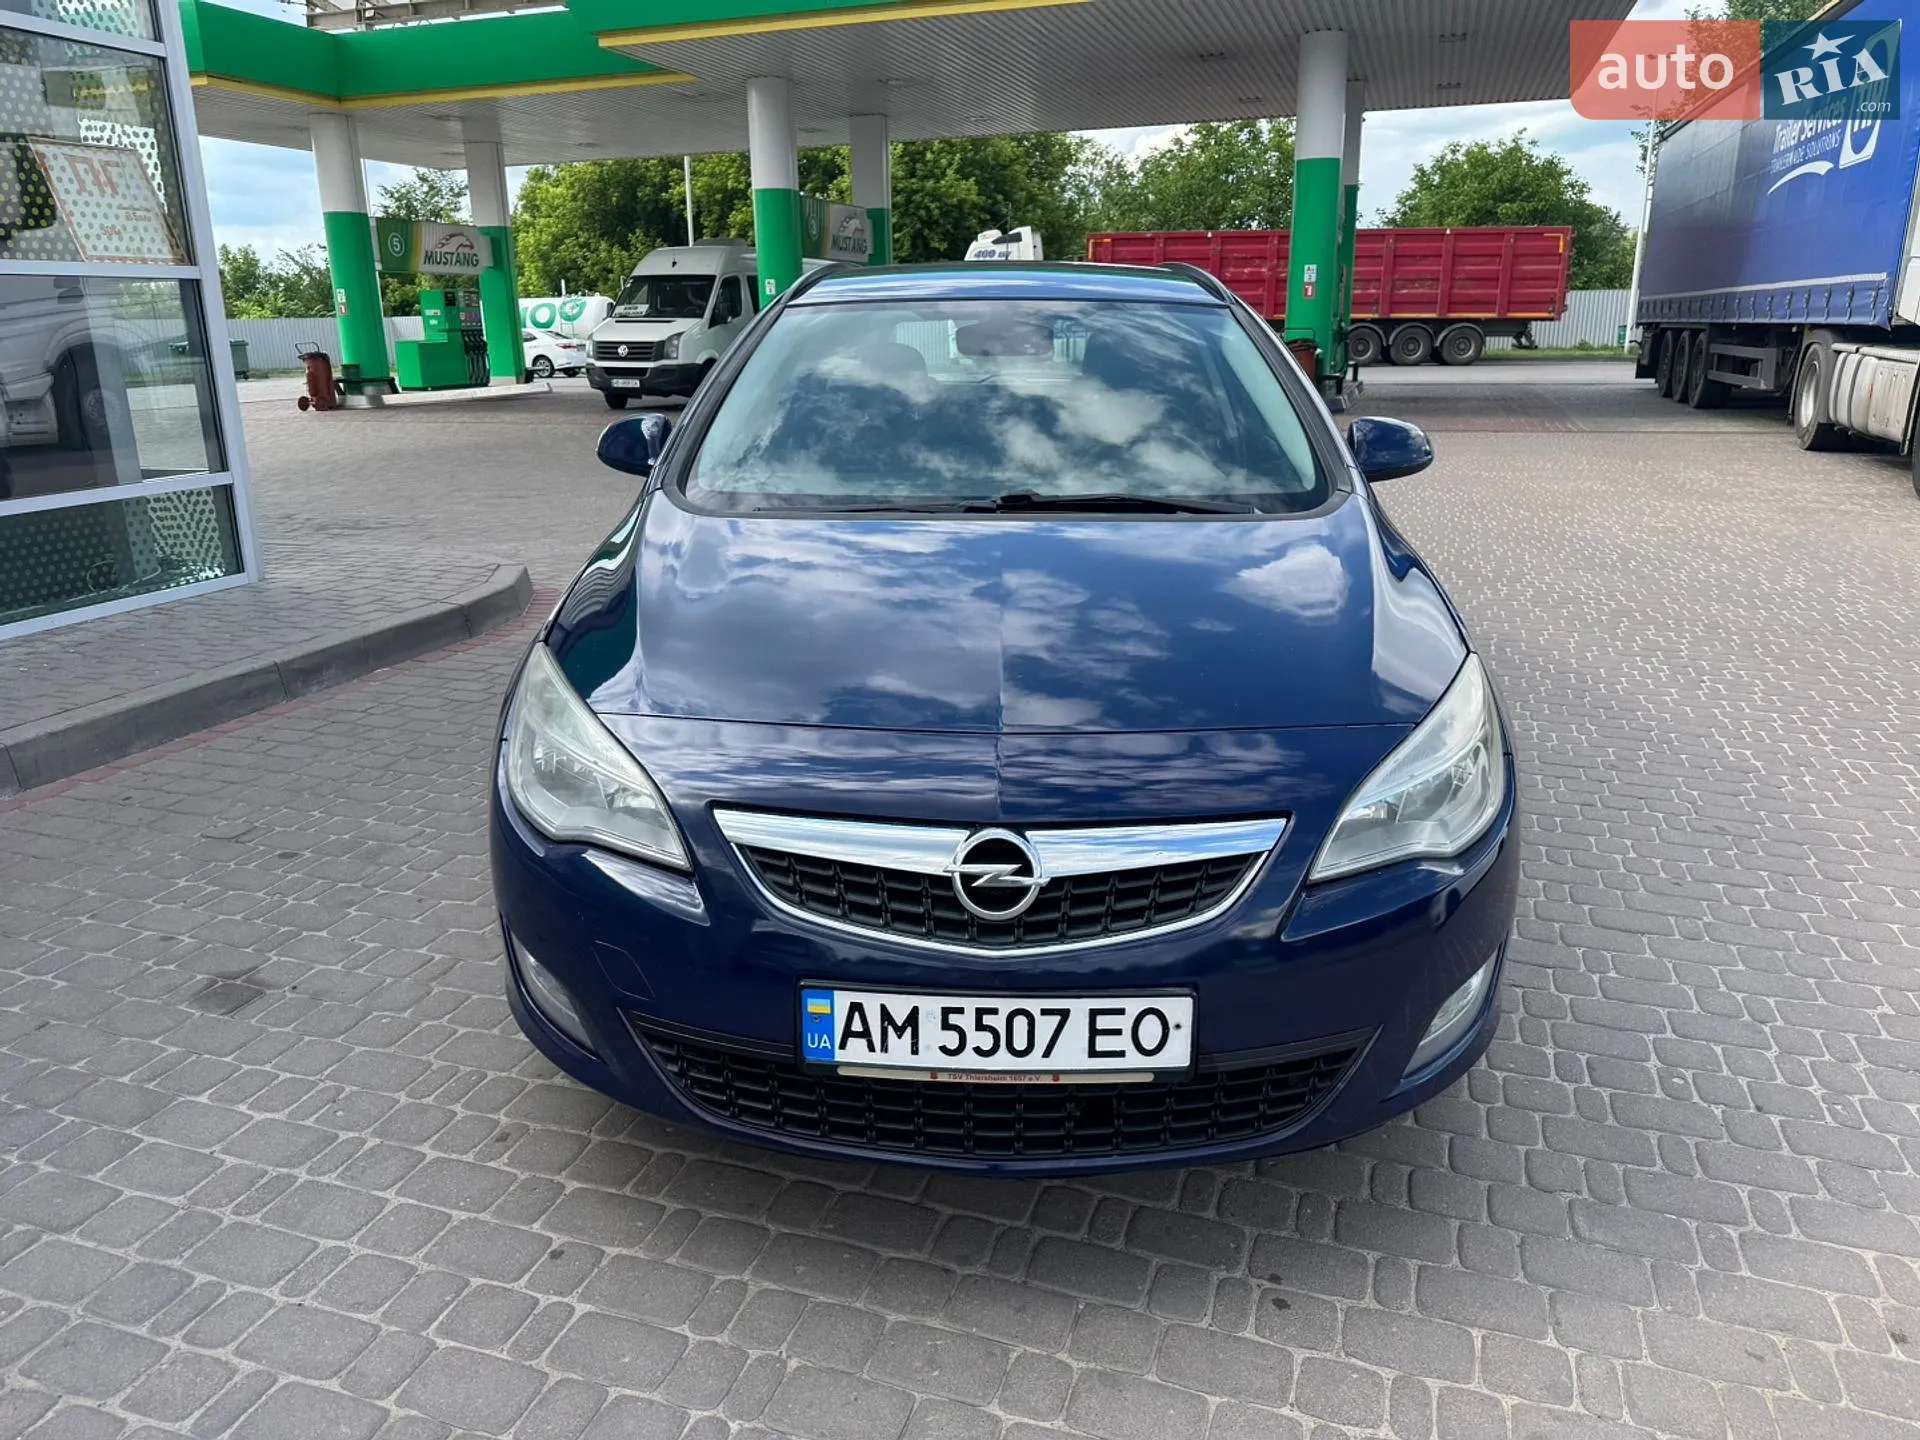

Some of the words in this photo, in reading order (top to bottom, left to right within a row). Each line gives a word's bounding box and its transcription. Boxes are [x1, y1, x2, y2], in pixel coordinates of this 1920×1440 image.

[392, 238, 401, 252] 5
[831, 234, 868, 255] MUSTANG
[423, 250, 479, 267] MUSTANG
[838, 1000, 920, 1056] AM
[937, 1006, 1072, 1060] 5507
[1087, 1006, 1171, 1060] EO
[807, 1032, 832, 1050] UA
